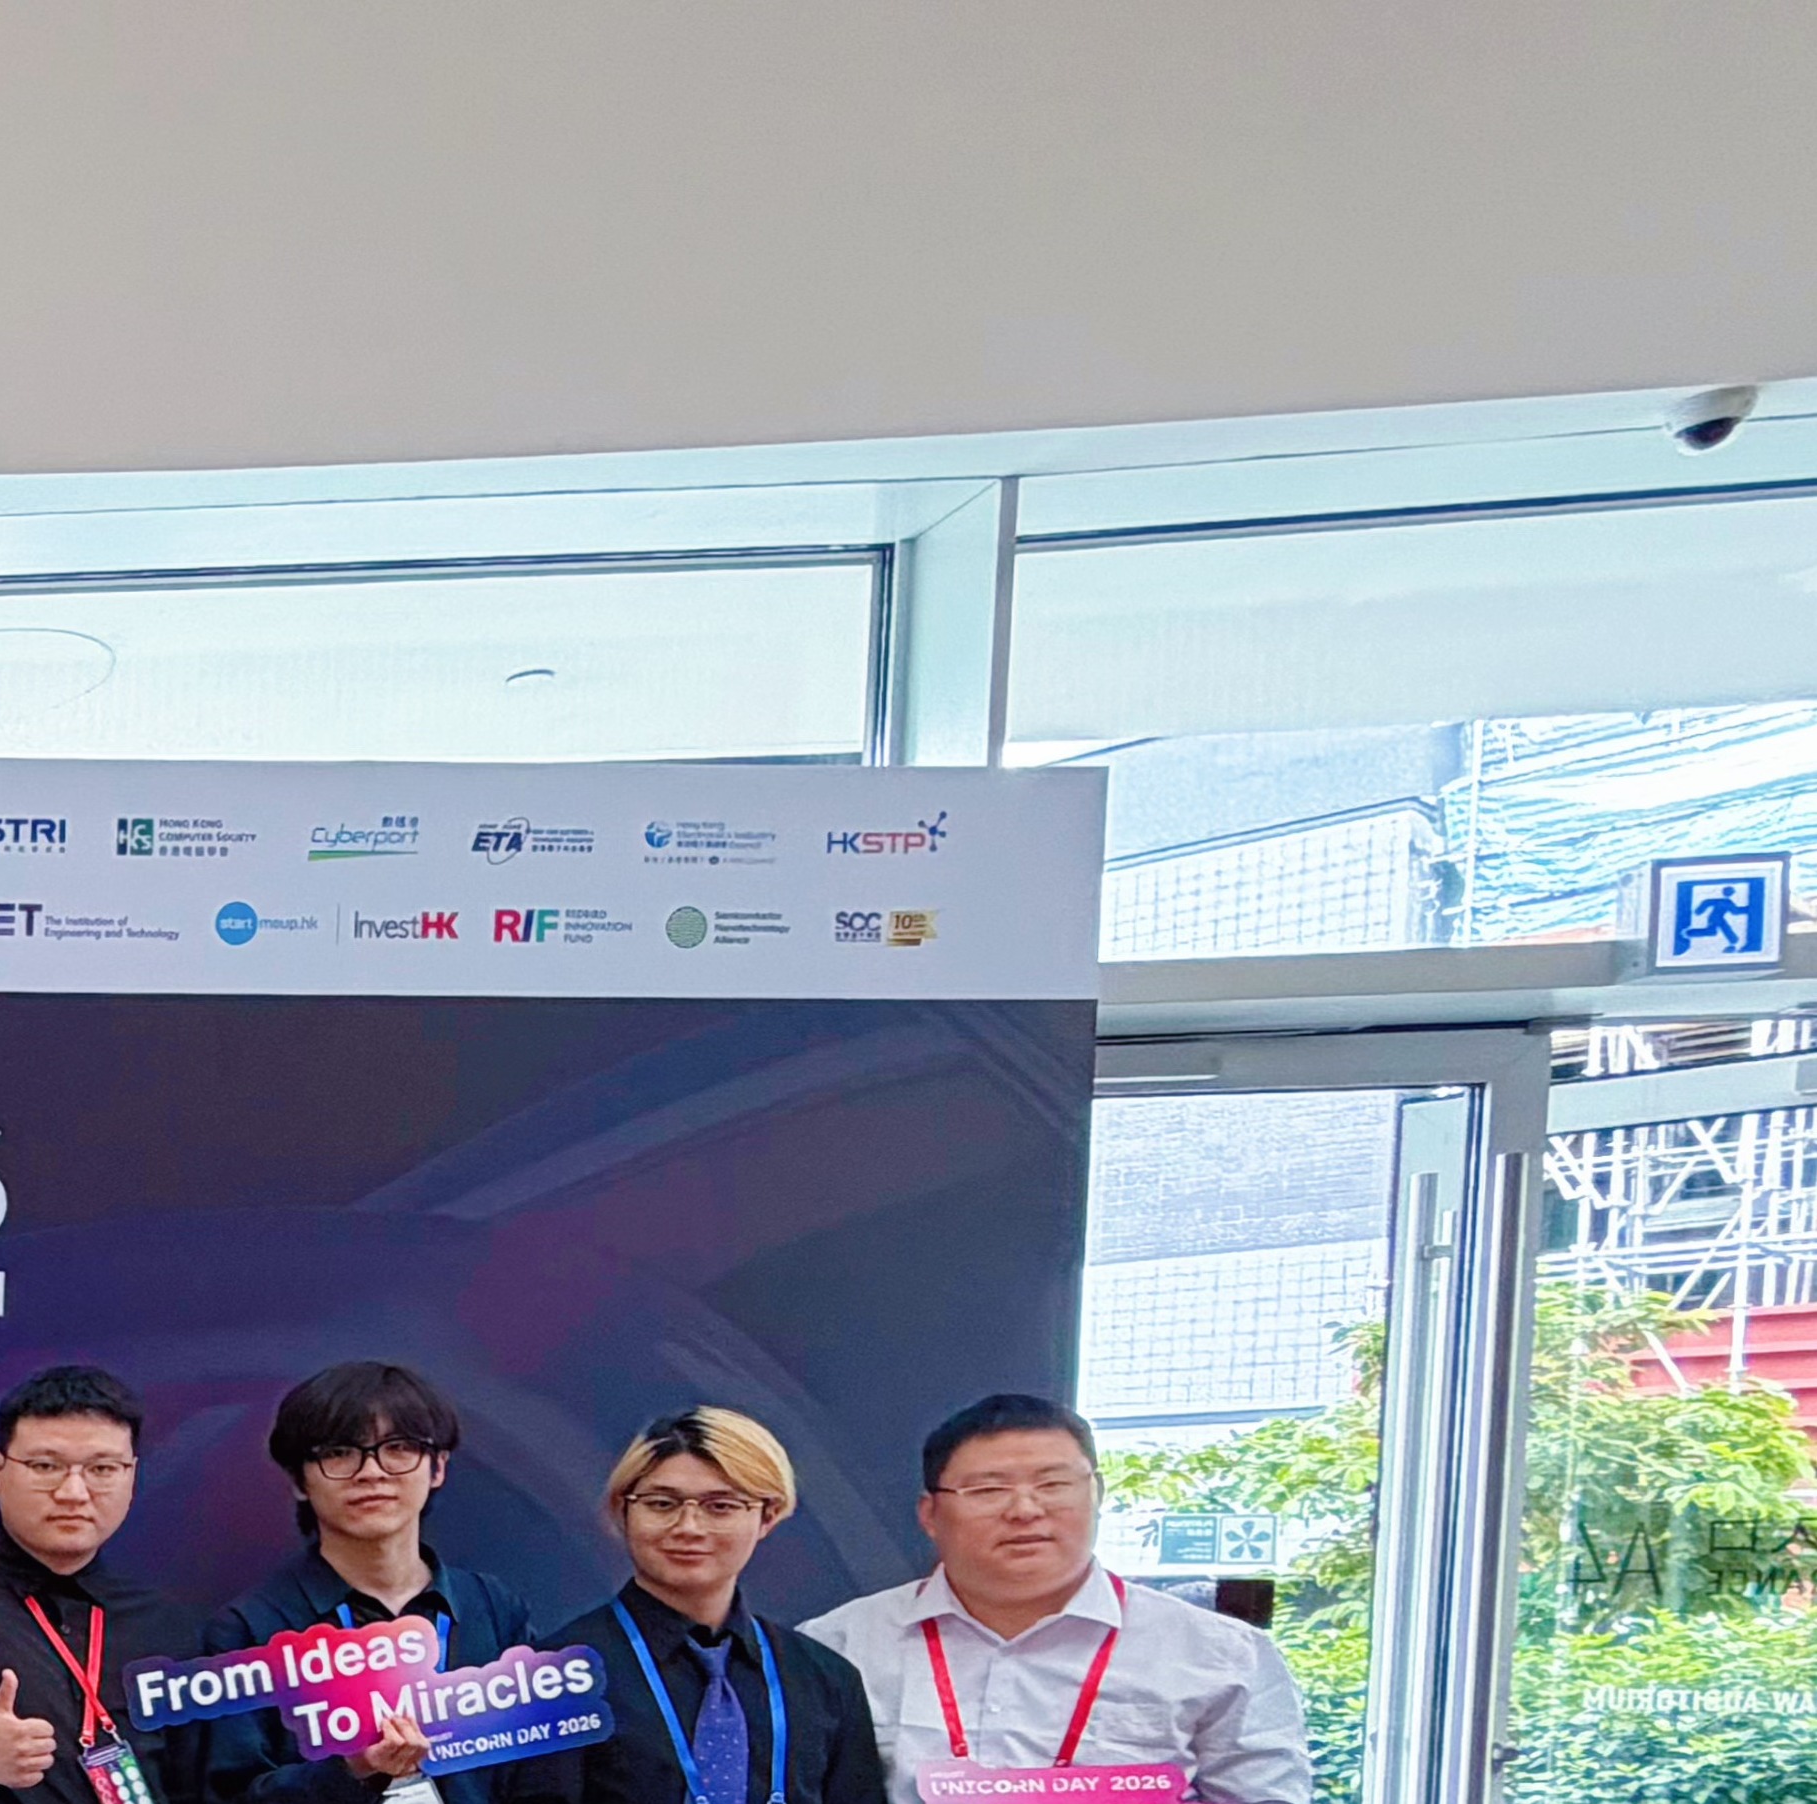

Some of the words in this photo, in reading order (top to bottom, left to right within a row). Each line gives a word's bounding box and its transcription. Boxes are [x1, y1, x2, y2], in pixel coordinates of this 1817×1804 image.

[311, 824, 419, 852] Cyberport
[472, 832, 522, 852] ETA
[827, 831, 926, 854] HKSTP
[45, 928, 102, 940] Engineering
[126, 929, 180, 942] Technology
[354, 911, 459, 939] InvestHK
[494, 909, 560, 943] RIF
[835, 912, 882, 932] SCC
[136, 1659, 273, 1717] From
[282, 1629, 427, 1688] Ideas
[293, 1700, 360, 1748] To
[370, 1657, 594, 1731] Miracles
